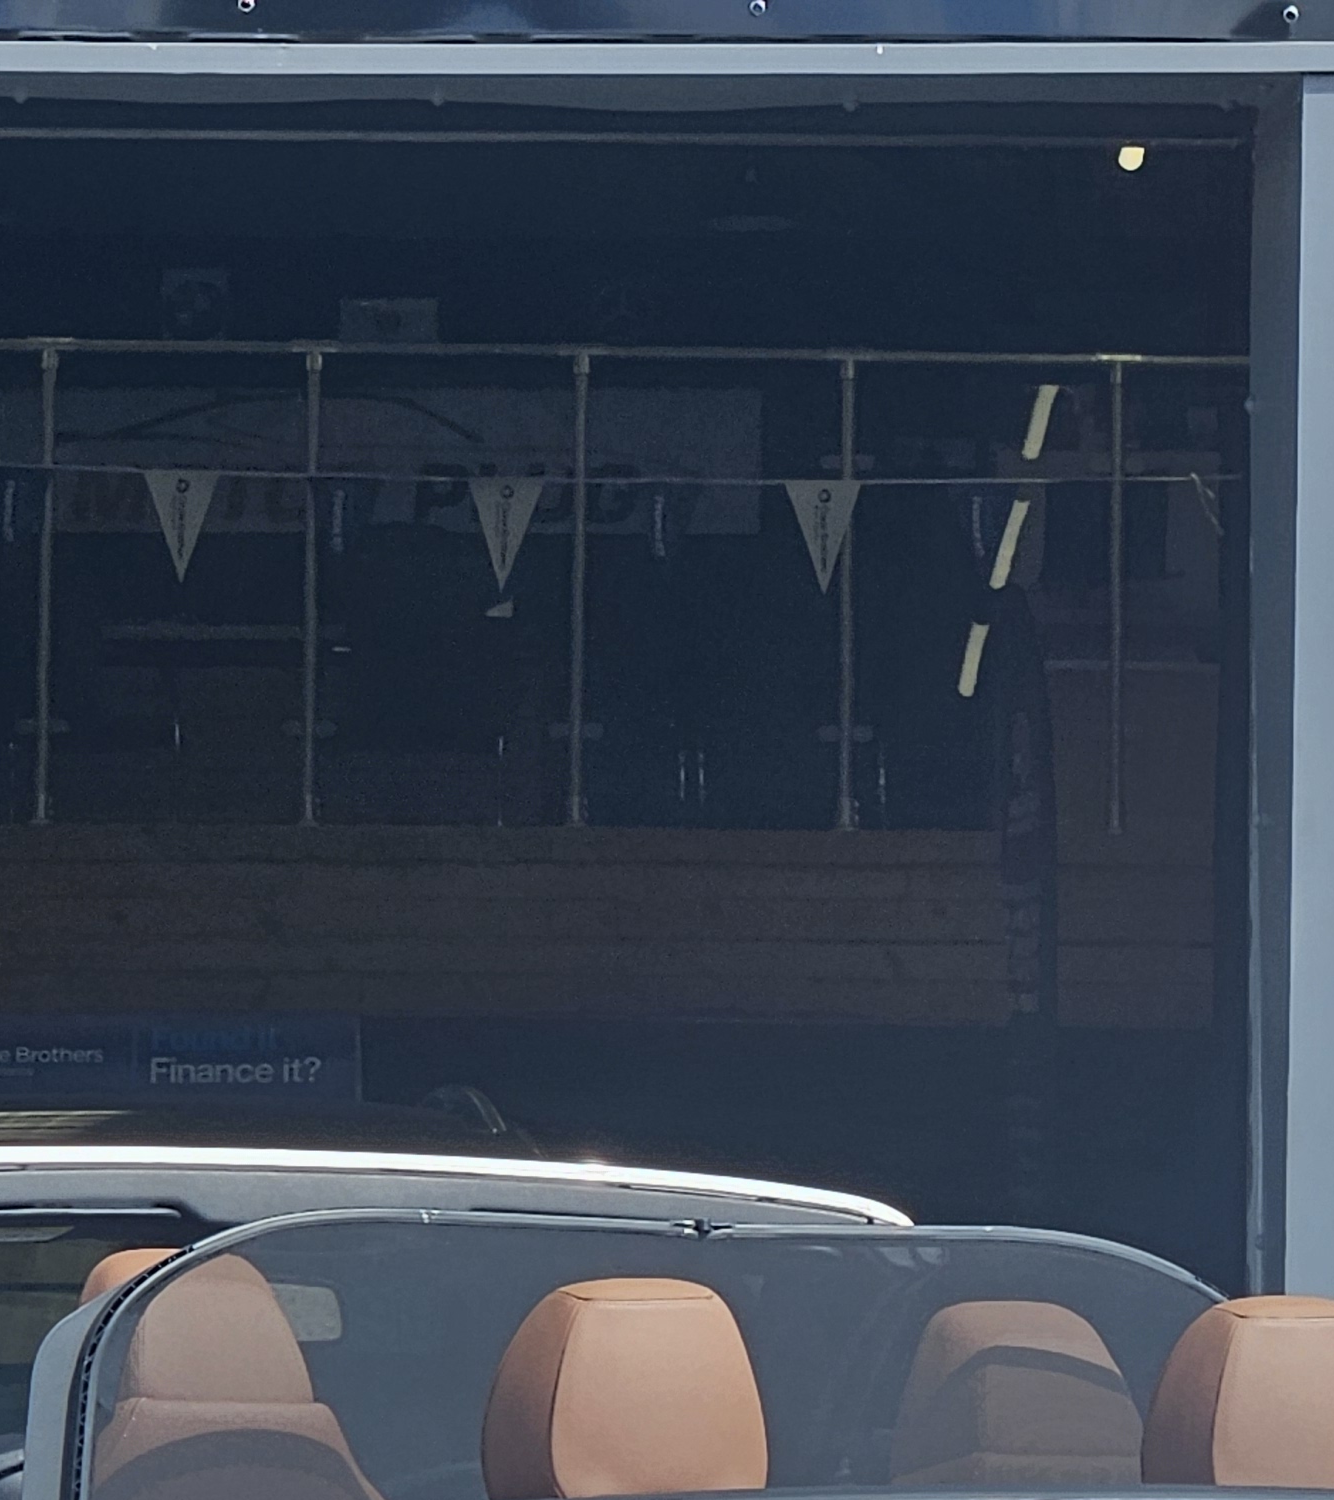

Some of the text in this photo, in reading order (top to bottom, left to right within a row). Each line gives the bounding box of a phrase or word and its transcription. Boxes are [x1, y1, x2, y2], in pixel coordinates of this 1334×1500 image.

[16, 1046, 104, 1063] Brothers
[150, 1056, 322, 1084] Finance it?
